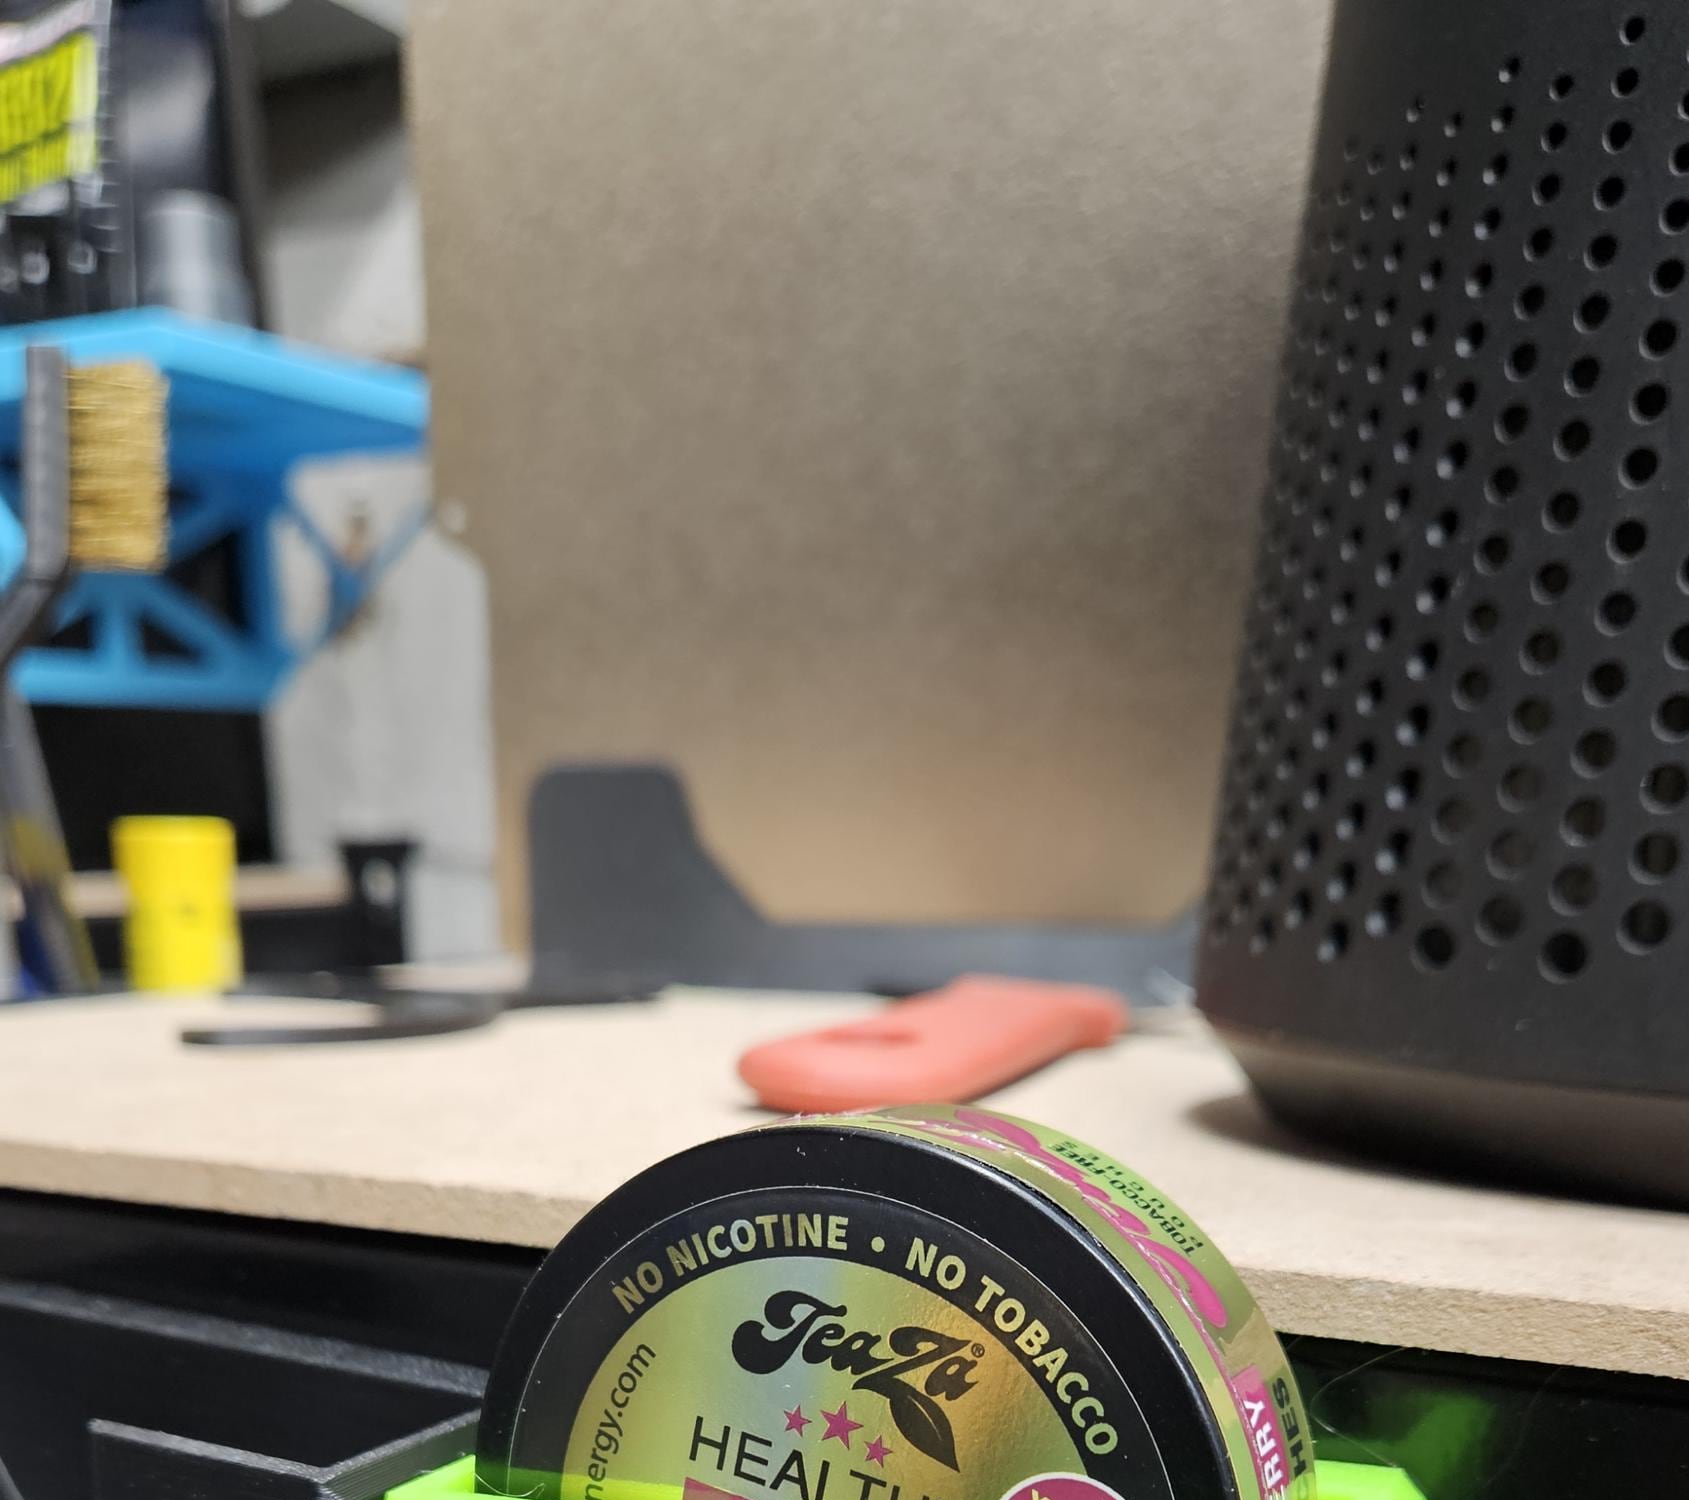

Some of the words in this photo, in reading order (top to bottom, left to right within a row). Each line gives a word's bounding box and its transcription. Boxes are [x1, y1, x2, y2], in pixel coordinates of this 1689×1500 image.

[1050, 1143, 1196, 1256] TOBACCO-FREE
[611, 1260, 664, 1315] NO
[666, 1213, 849, 1278] NICOTINE
[905, 1237, 967, 1291] NO
[973, 1275, 1119, 1455] TOBACCO
